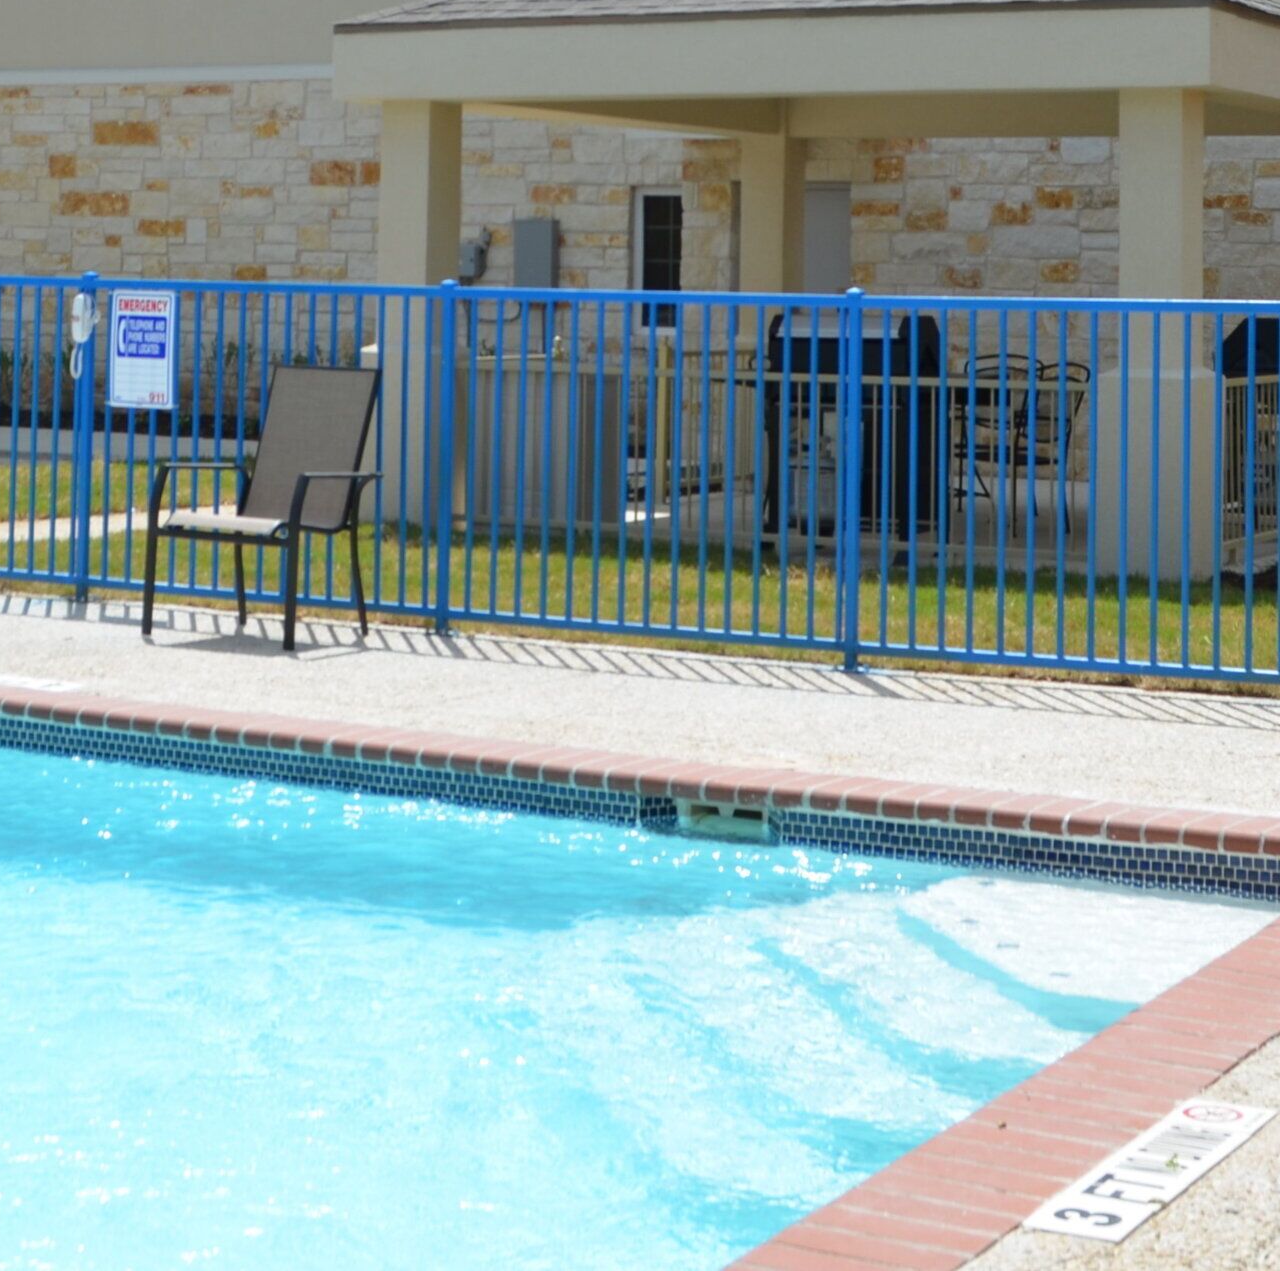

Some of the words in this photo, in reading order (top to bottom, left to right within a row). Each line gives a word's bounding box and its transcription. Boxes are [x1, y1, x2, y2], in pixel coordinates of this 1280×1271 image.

[118, 298, 168, 313] EMERGENCY
[149, 392, 165, 404] 911
[1081, 1173, 1167, 1206] FT
[1053, 1207, 1123, 1227] 3
